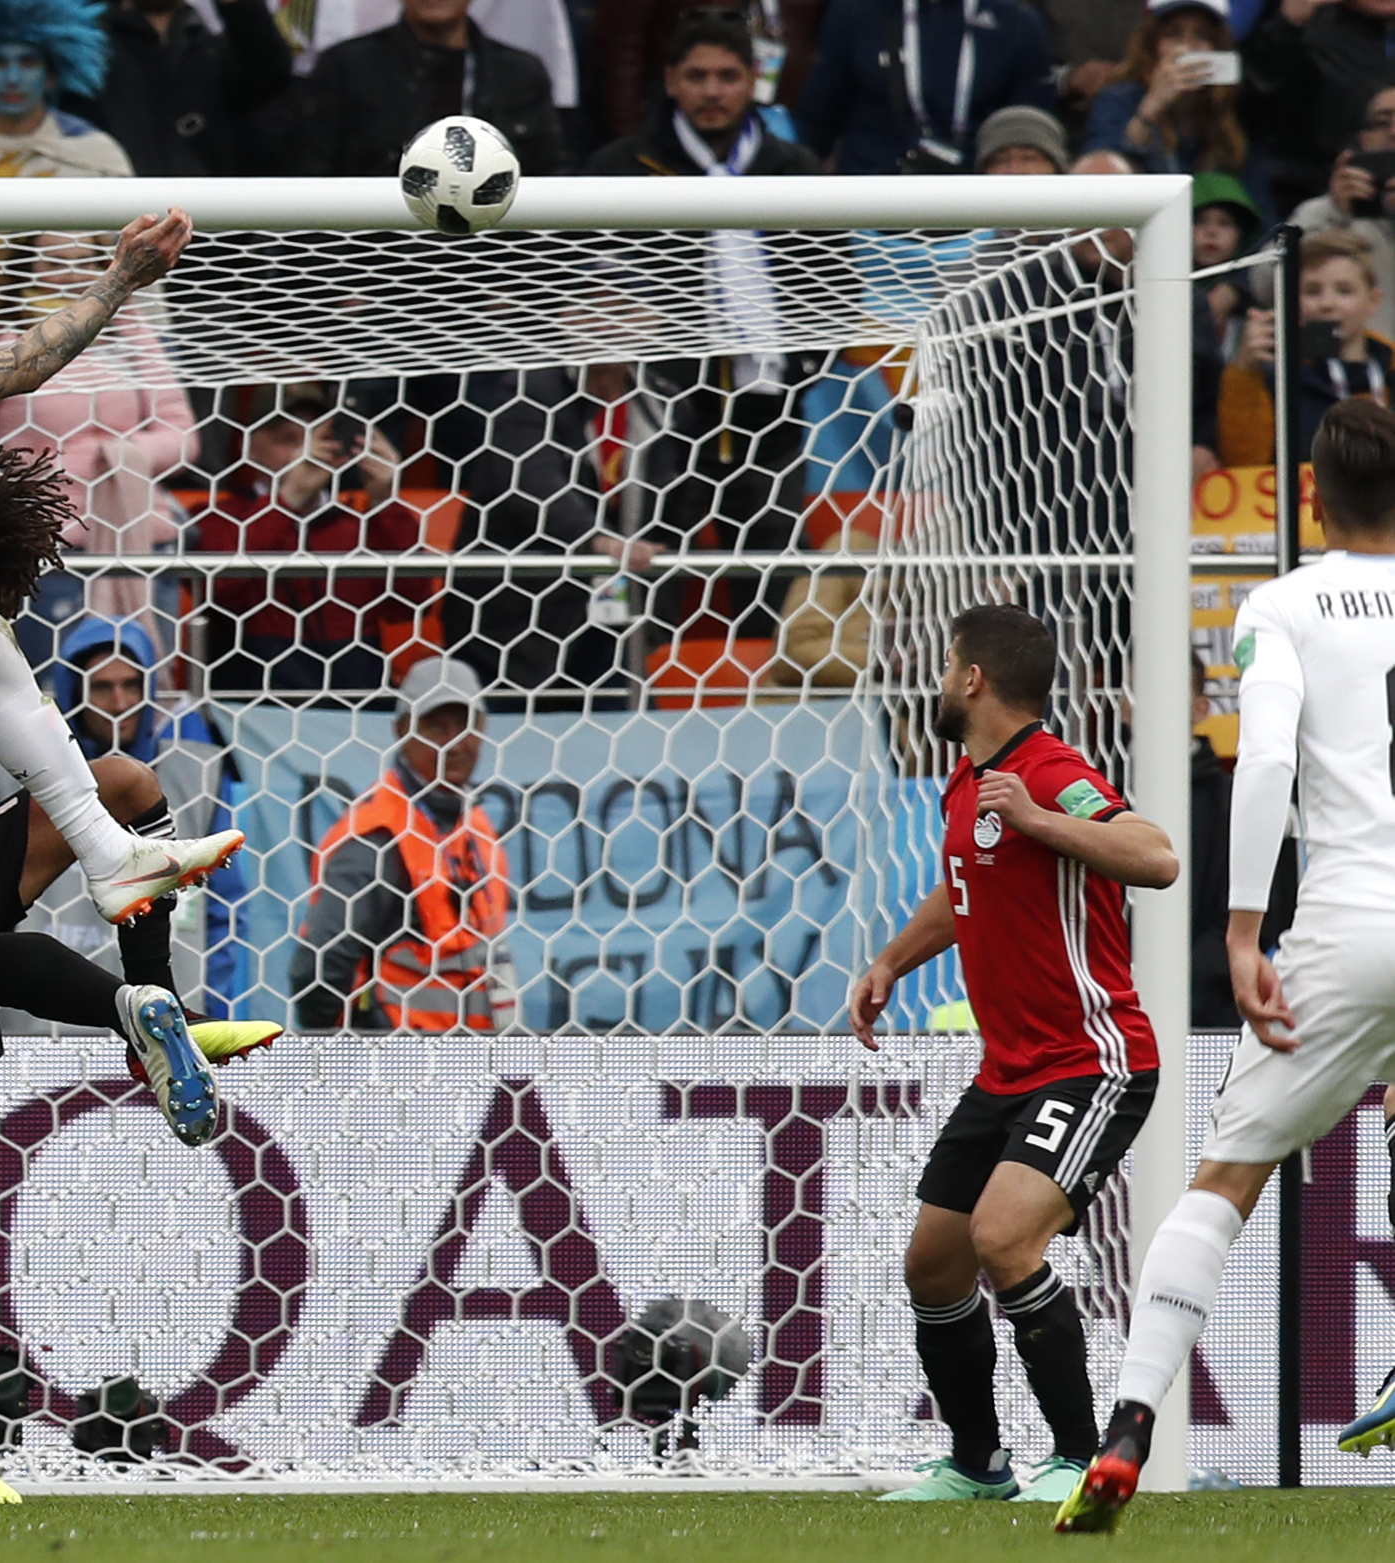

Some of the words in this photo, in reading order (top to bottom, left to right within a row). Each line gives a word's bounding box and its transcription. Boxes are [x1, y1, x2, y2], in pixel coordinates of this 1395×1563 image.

[1316, 588, 1395, 621] R.BEN
[949, 855, 971, 917] 5
[1024, 1099, 1075, 1153] 5
